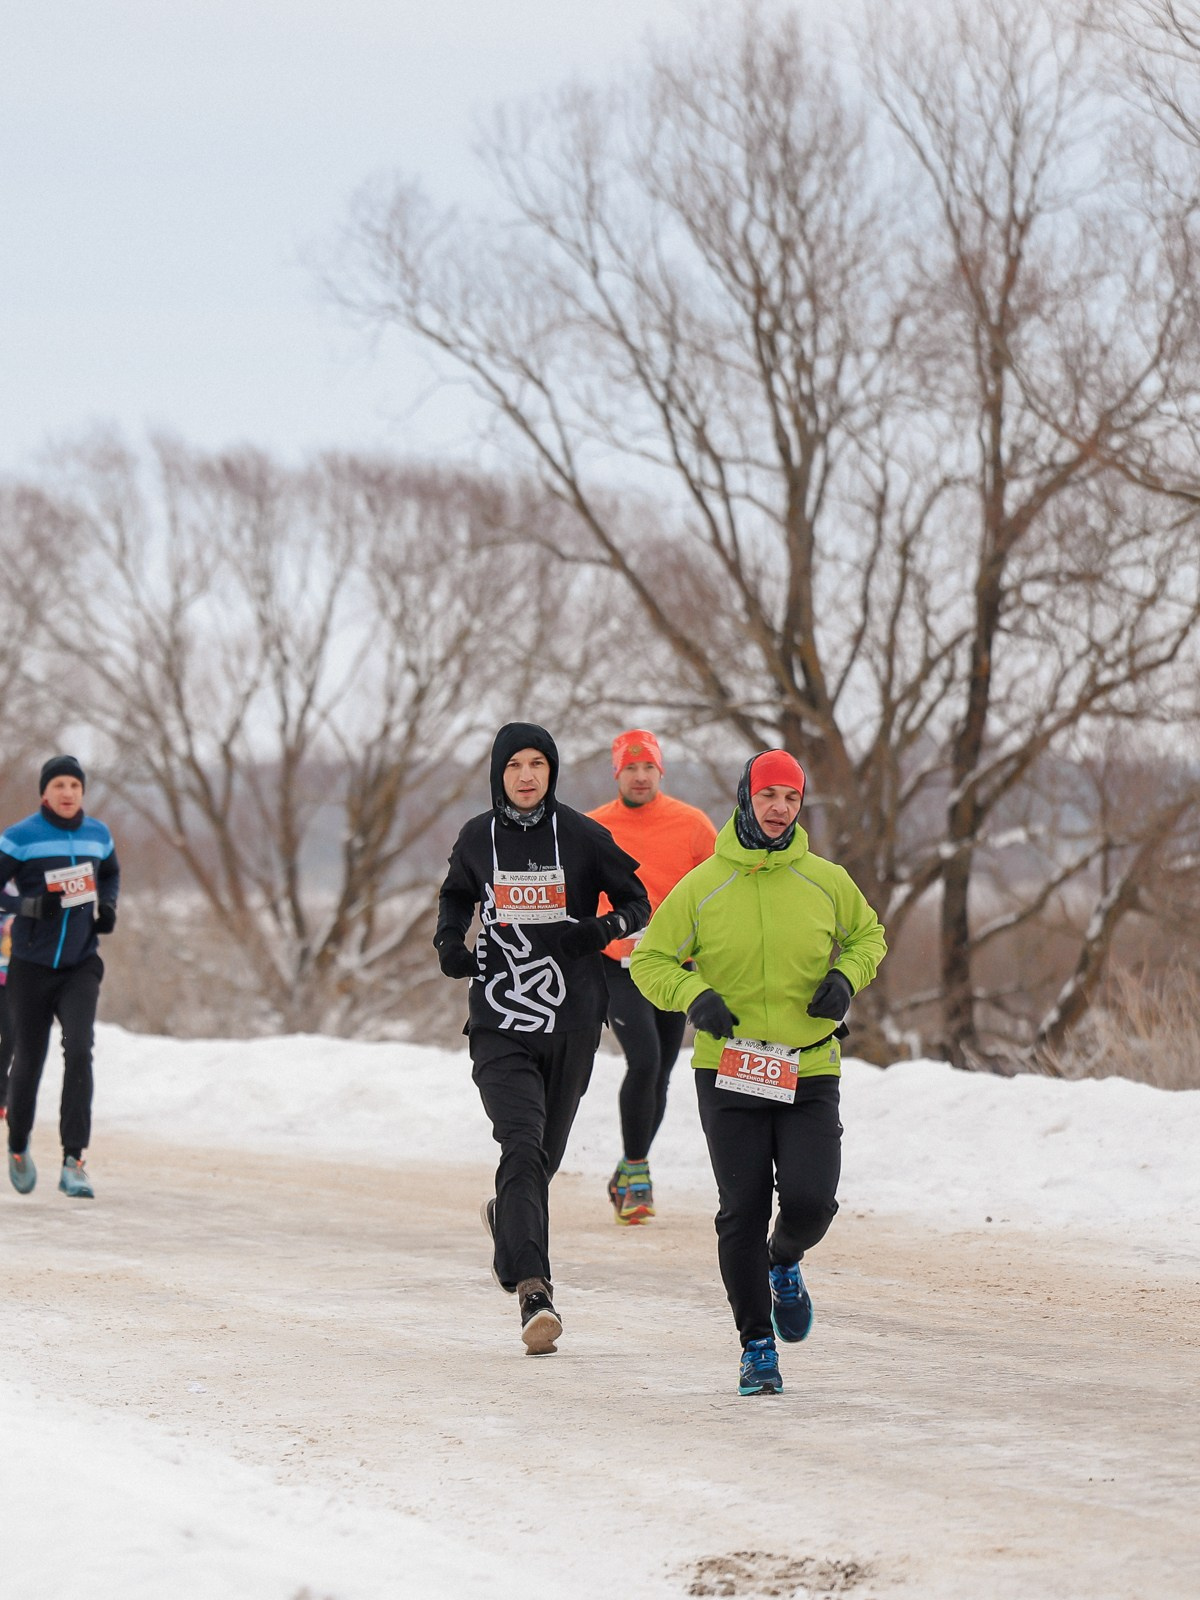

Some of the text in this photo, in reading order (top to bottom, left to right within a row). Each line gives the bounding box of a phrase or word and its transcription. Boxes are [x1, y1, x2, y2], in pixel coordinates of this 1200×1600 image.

[61, 878, 86, 895] 106
[509, 886, 550, 904] 001
[738, 1053, 781, 1079] 126
[764, 1077, 780, 1086] ОЛЕГ
